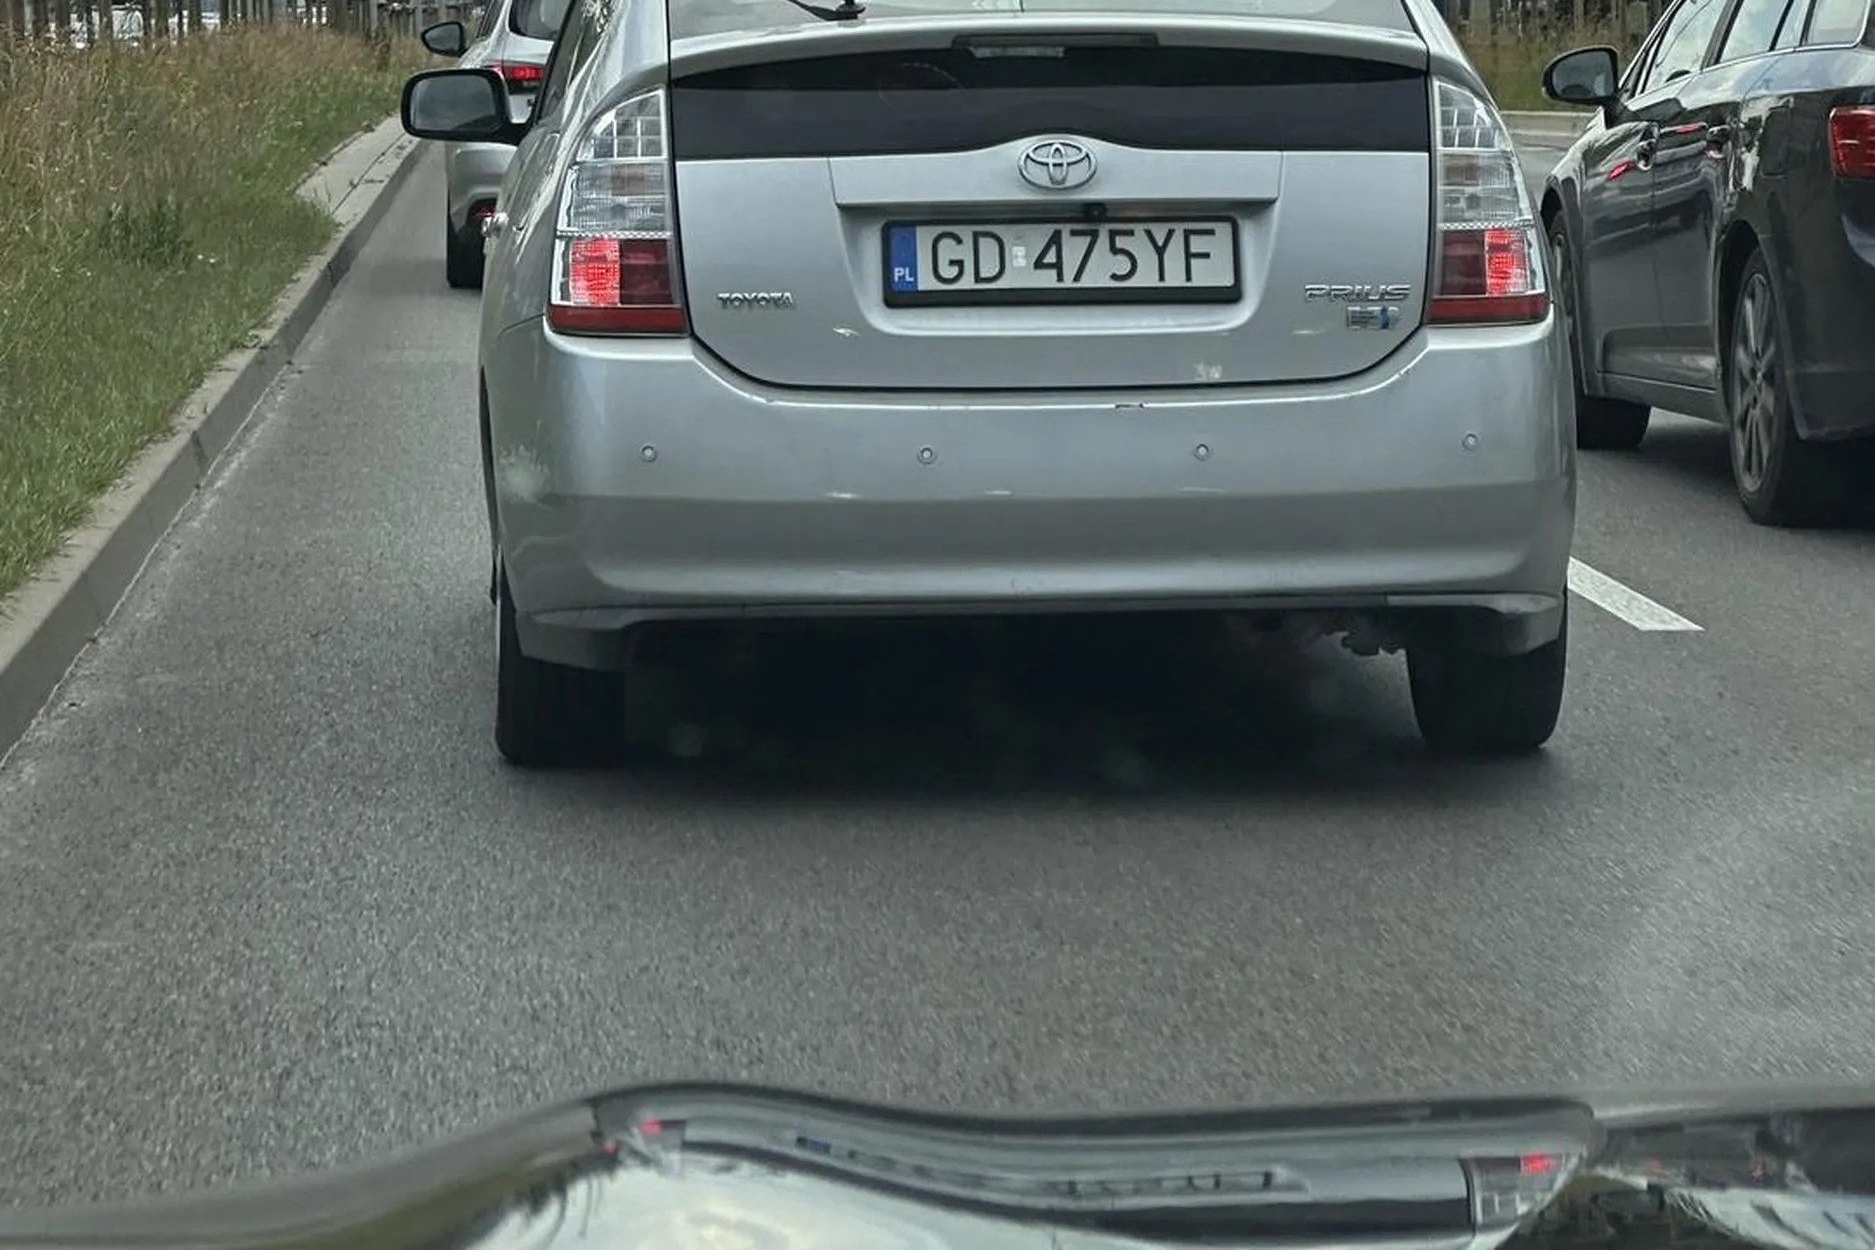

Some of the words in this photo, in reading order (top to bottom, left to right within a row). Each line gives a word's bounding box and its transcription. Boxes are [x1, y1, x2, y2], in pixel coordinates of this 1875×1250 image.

[931, 230, 1006, 284] GD
[1033, 228, 1217, 283] 475YF
[894, 267, 915, 282] PL
[717, 291, 795, 309] TOYOTA
[1305, 284, 1411, 302] PRIUS
